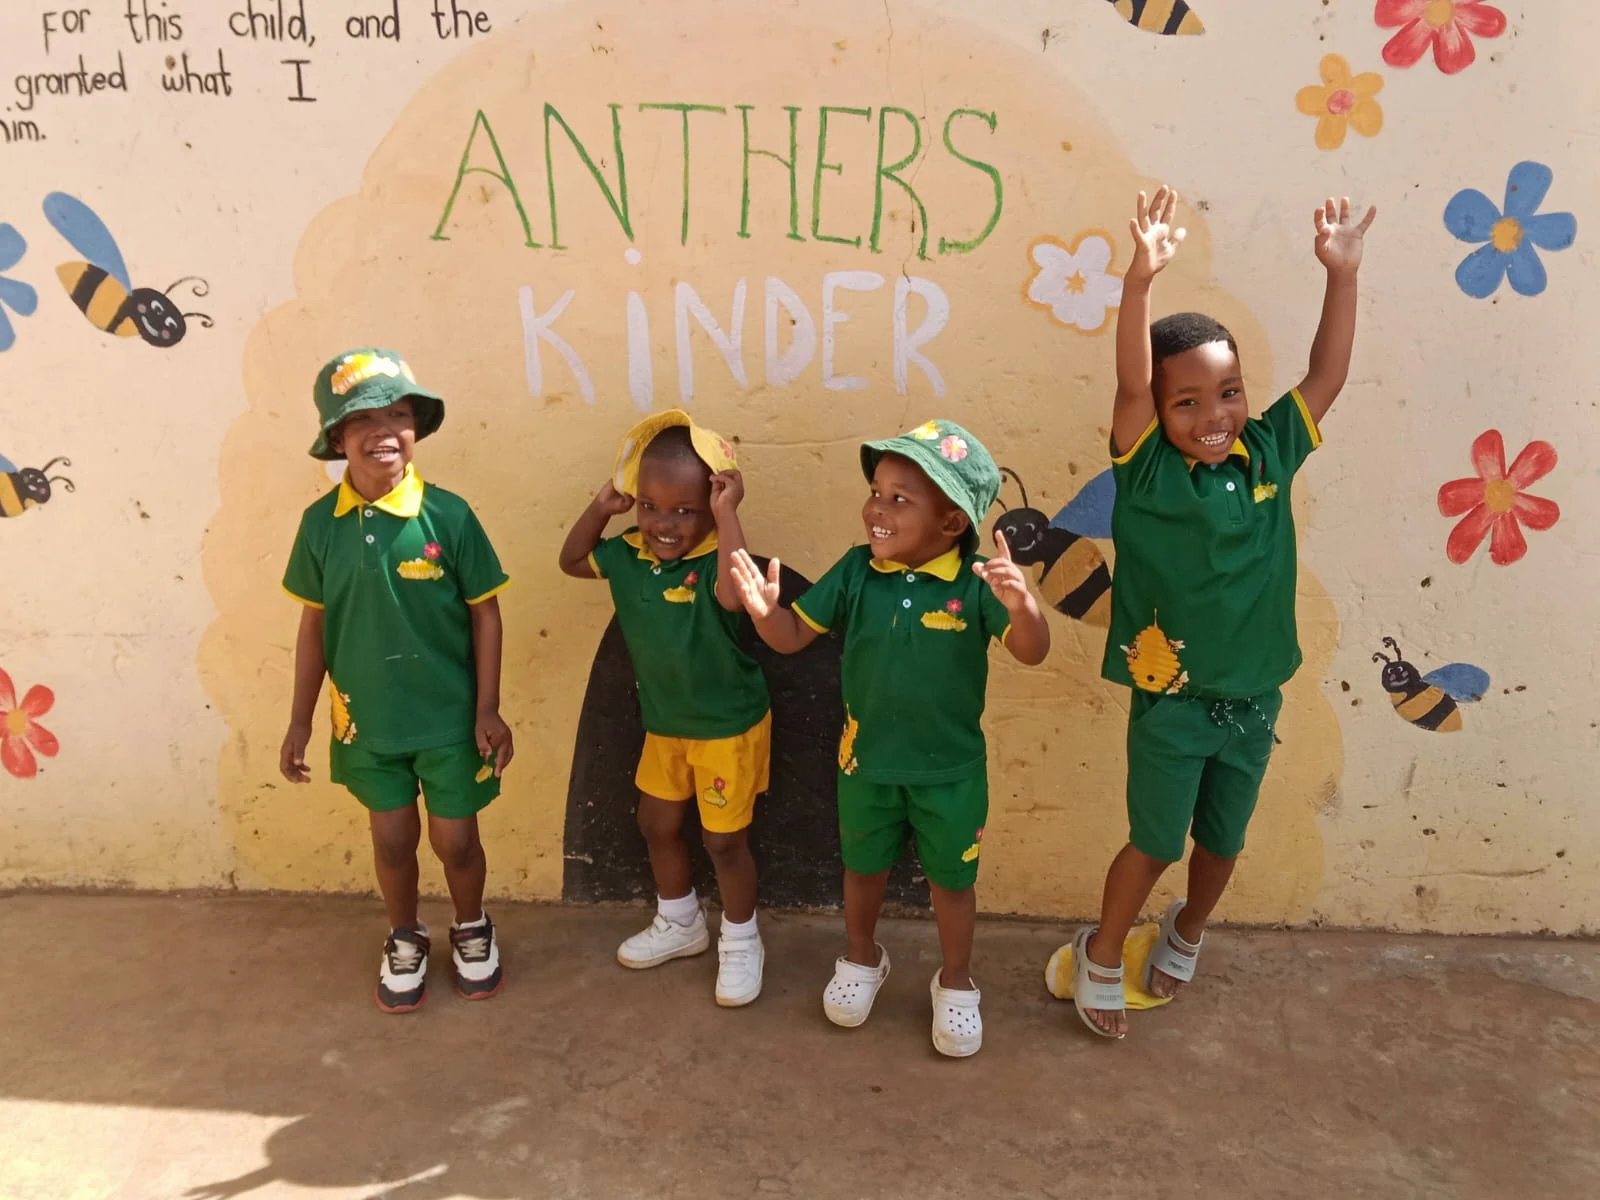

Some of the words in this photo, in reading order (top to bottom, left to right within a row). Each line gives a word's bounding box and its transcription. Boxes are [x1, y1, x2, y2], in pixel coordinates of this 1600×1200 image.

[123, 0, 183, 44] this
[228, 0, 316, 48] child,
[345, 0, 401, 42] and
[430, 0, 492, 40] the
[15, 50, 128, 111] granted
[161, 48, 232, 97] what
[280, 59, 317, 102] I
[429, 102, 1004, 260] ANTHERS
